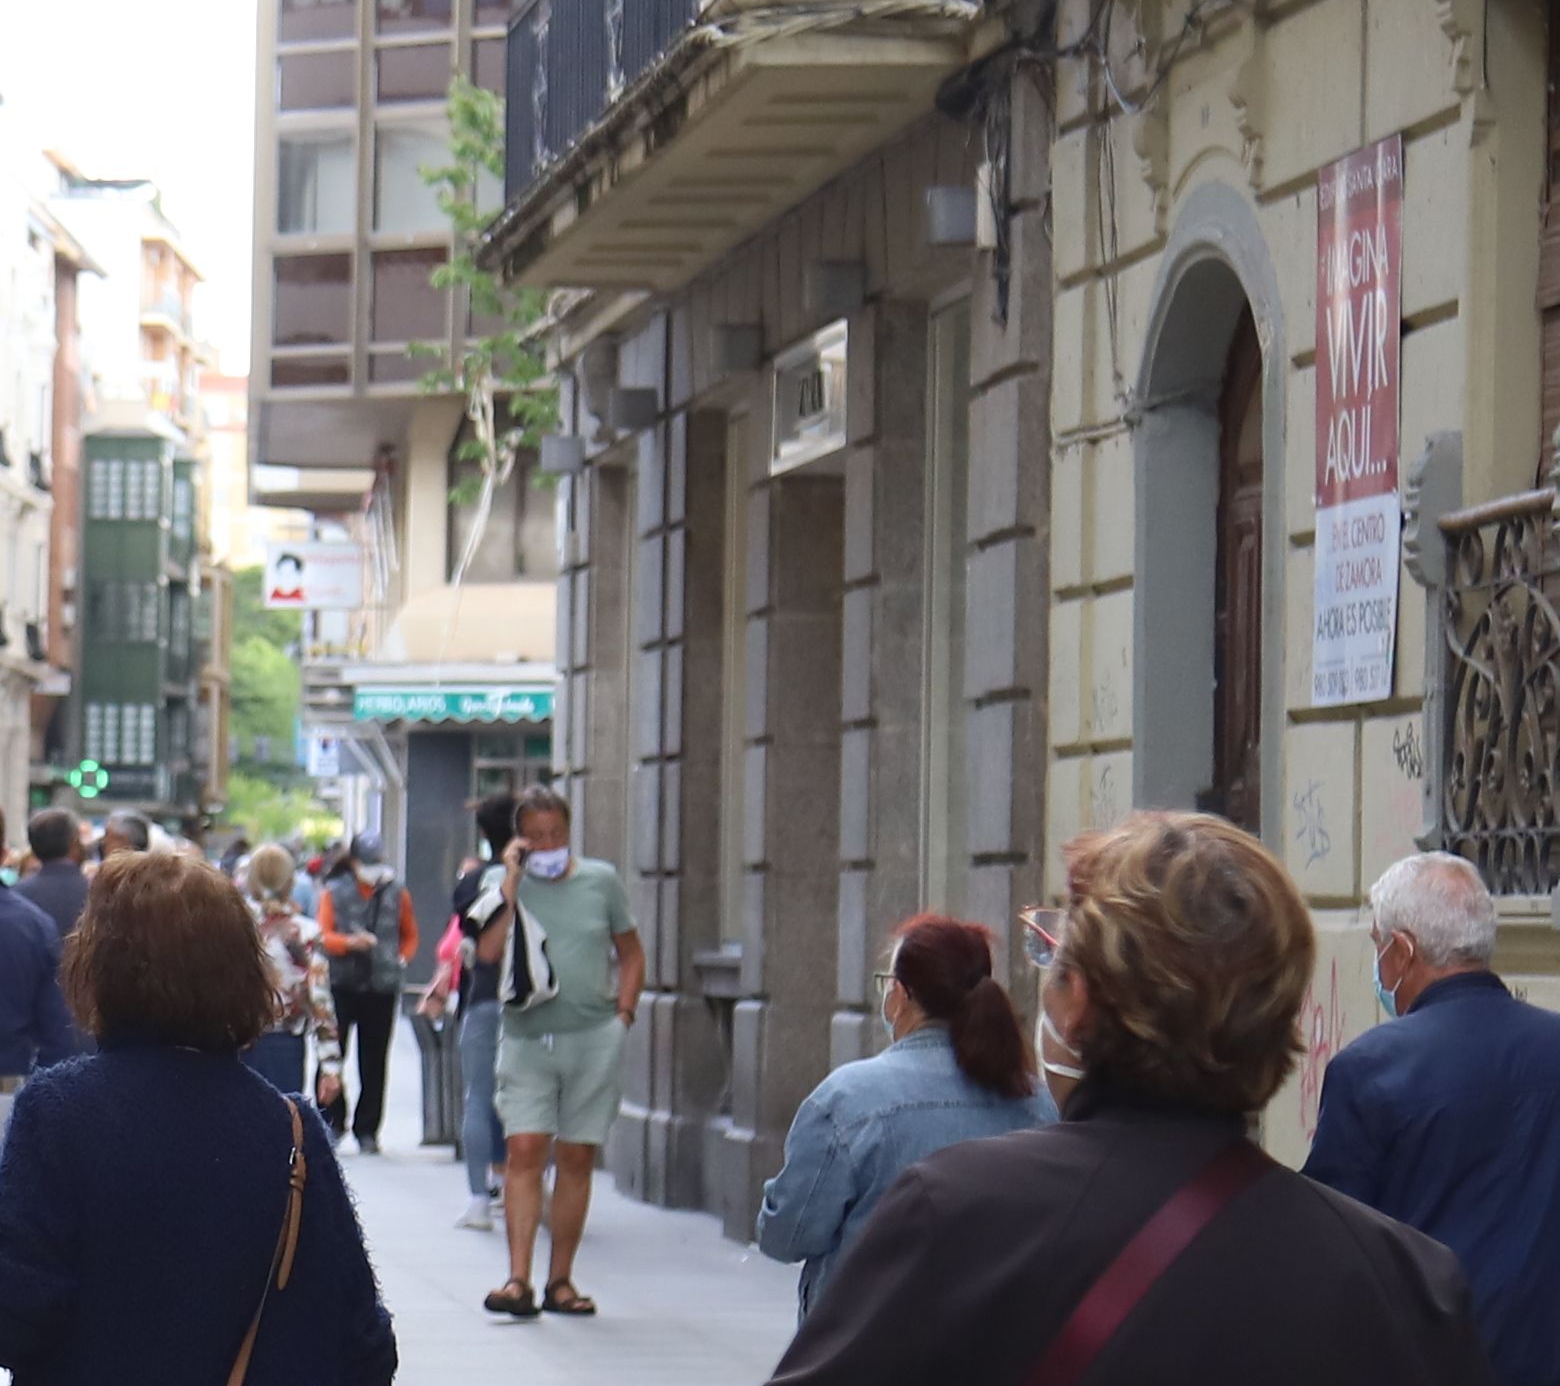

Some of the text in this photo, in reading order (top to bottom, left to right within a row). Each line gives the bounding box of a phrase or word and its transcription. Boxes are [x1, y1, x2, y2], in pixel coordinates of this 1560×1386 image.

[1326, 289, 1388, 403] VIVIR
[1351, 513, 1385, 548] CENTRO
[1345, 557, 1383, 591] ZAMORA
[1346, 603, 1357, 636] ES
